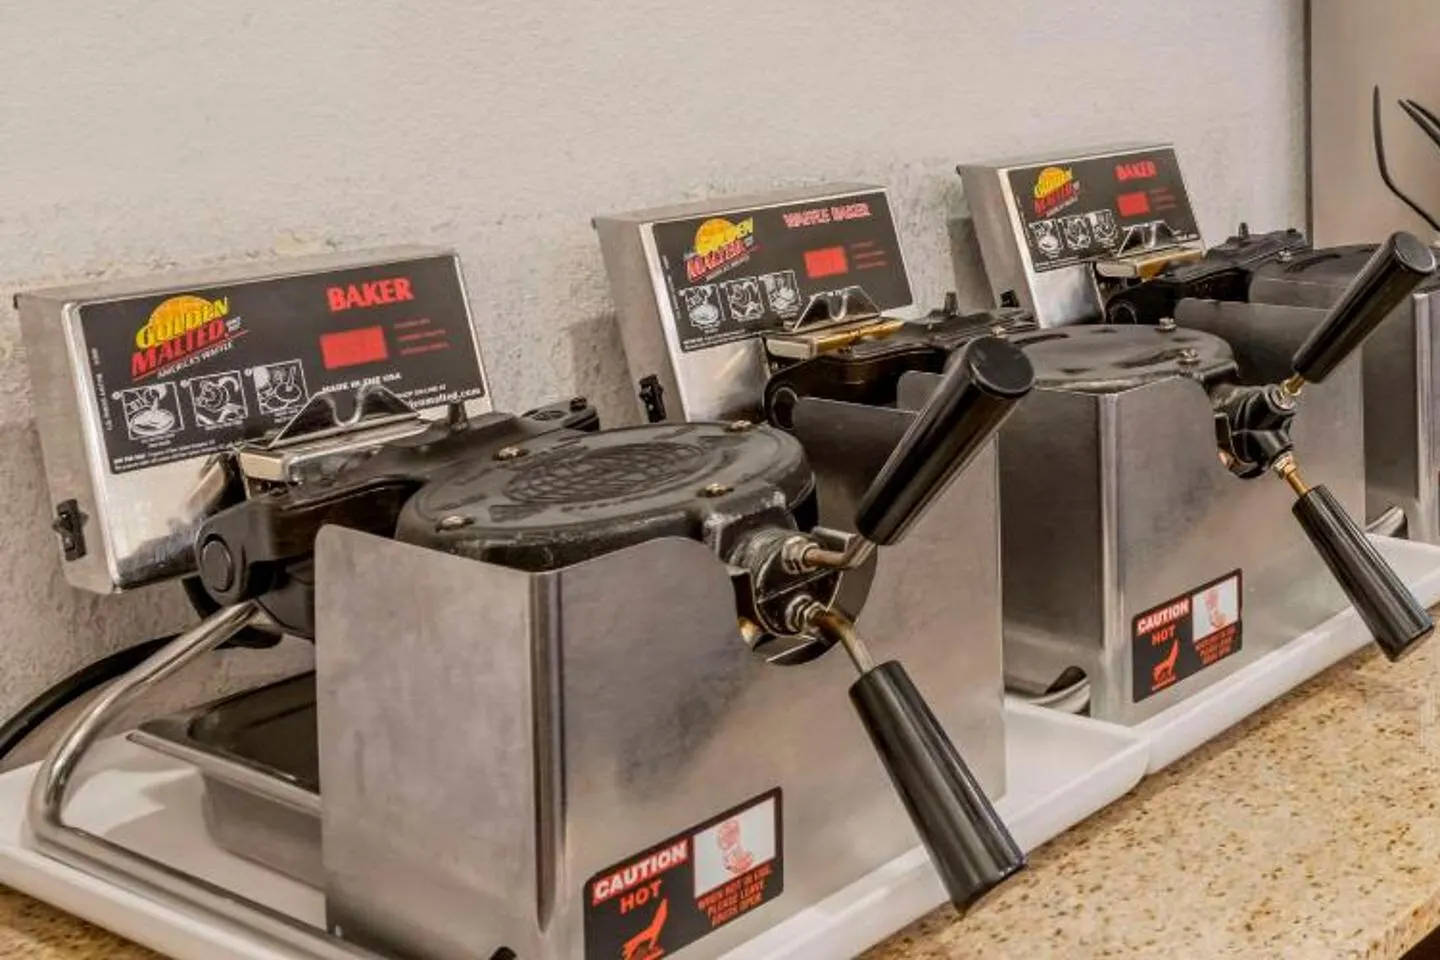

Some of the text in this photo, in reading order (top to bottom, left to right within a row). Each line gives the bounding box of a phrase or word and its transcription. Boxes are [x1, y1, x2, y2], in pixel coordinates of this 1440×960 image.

[1115, 161, 1156, 181] BAKER
[326, 277, 415, 312] BAKER
[136, 296, 229, 349] GOLDEN
[131, 319, 225, 378] MALTED
[1137, 598, 1189, 635] CAUTION
[1152, 624, 1176, 646] HOT
[594, 840, 688, 900] CAUTION
[621, 879, 662, 915] HOT
